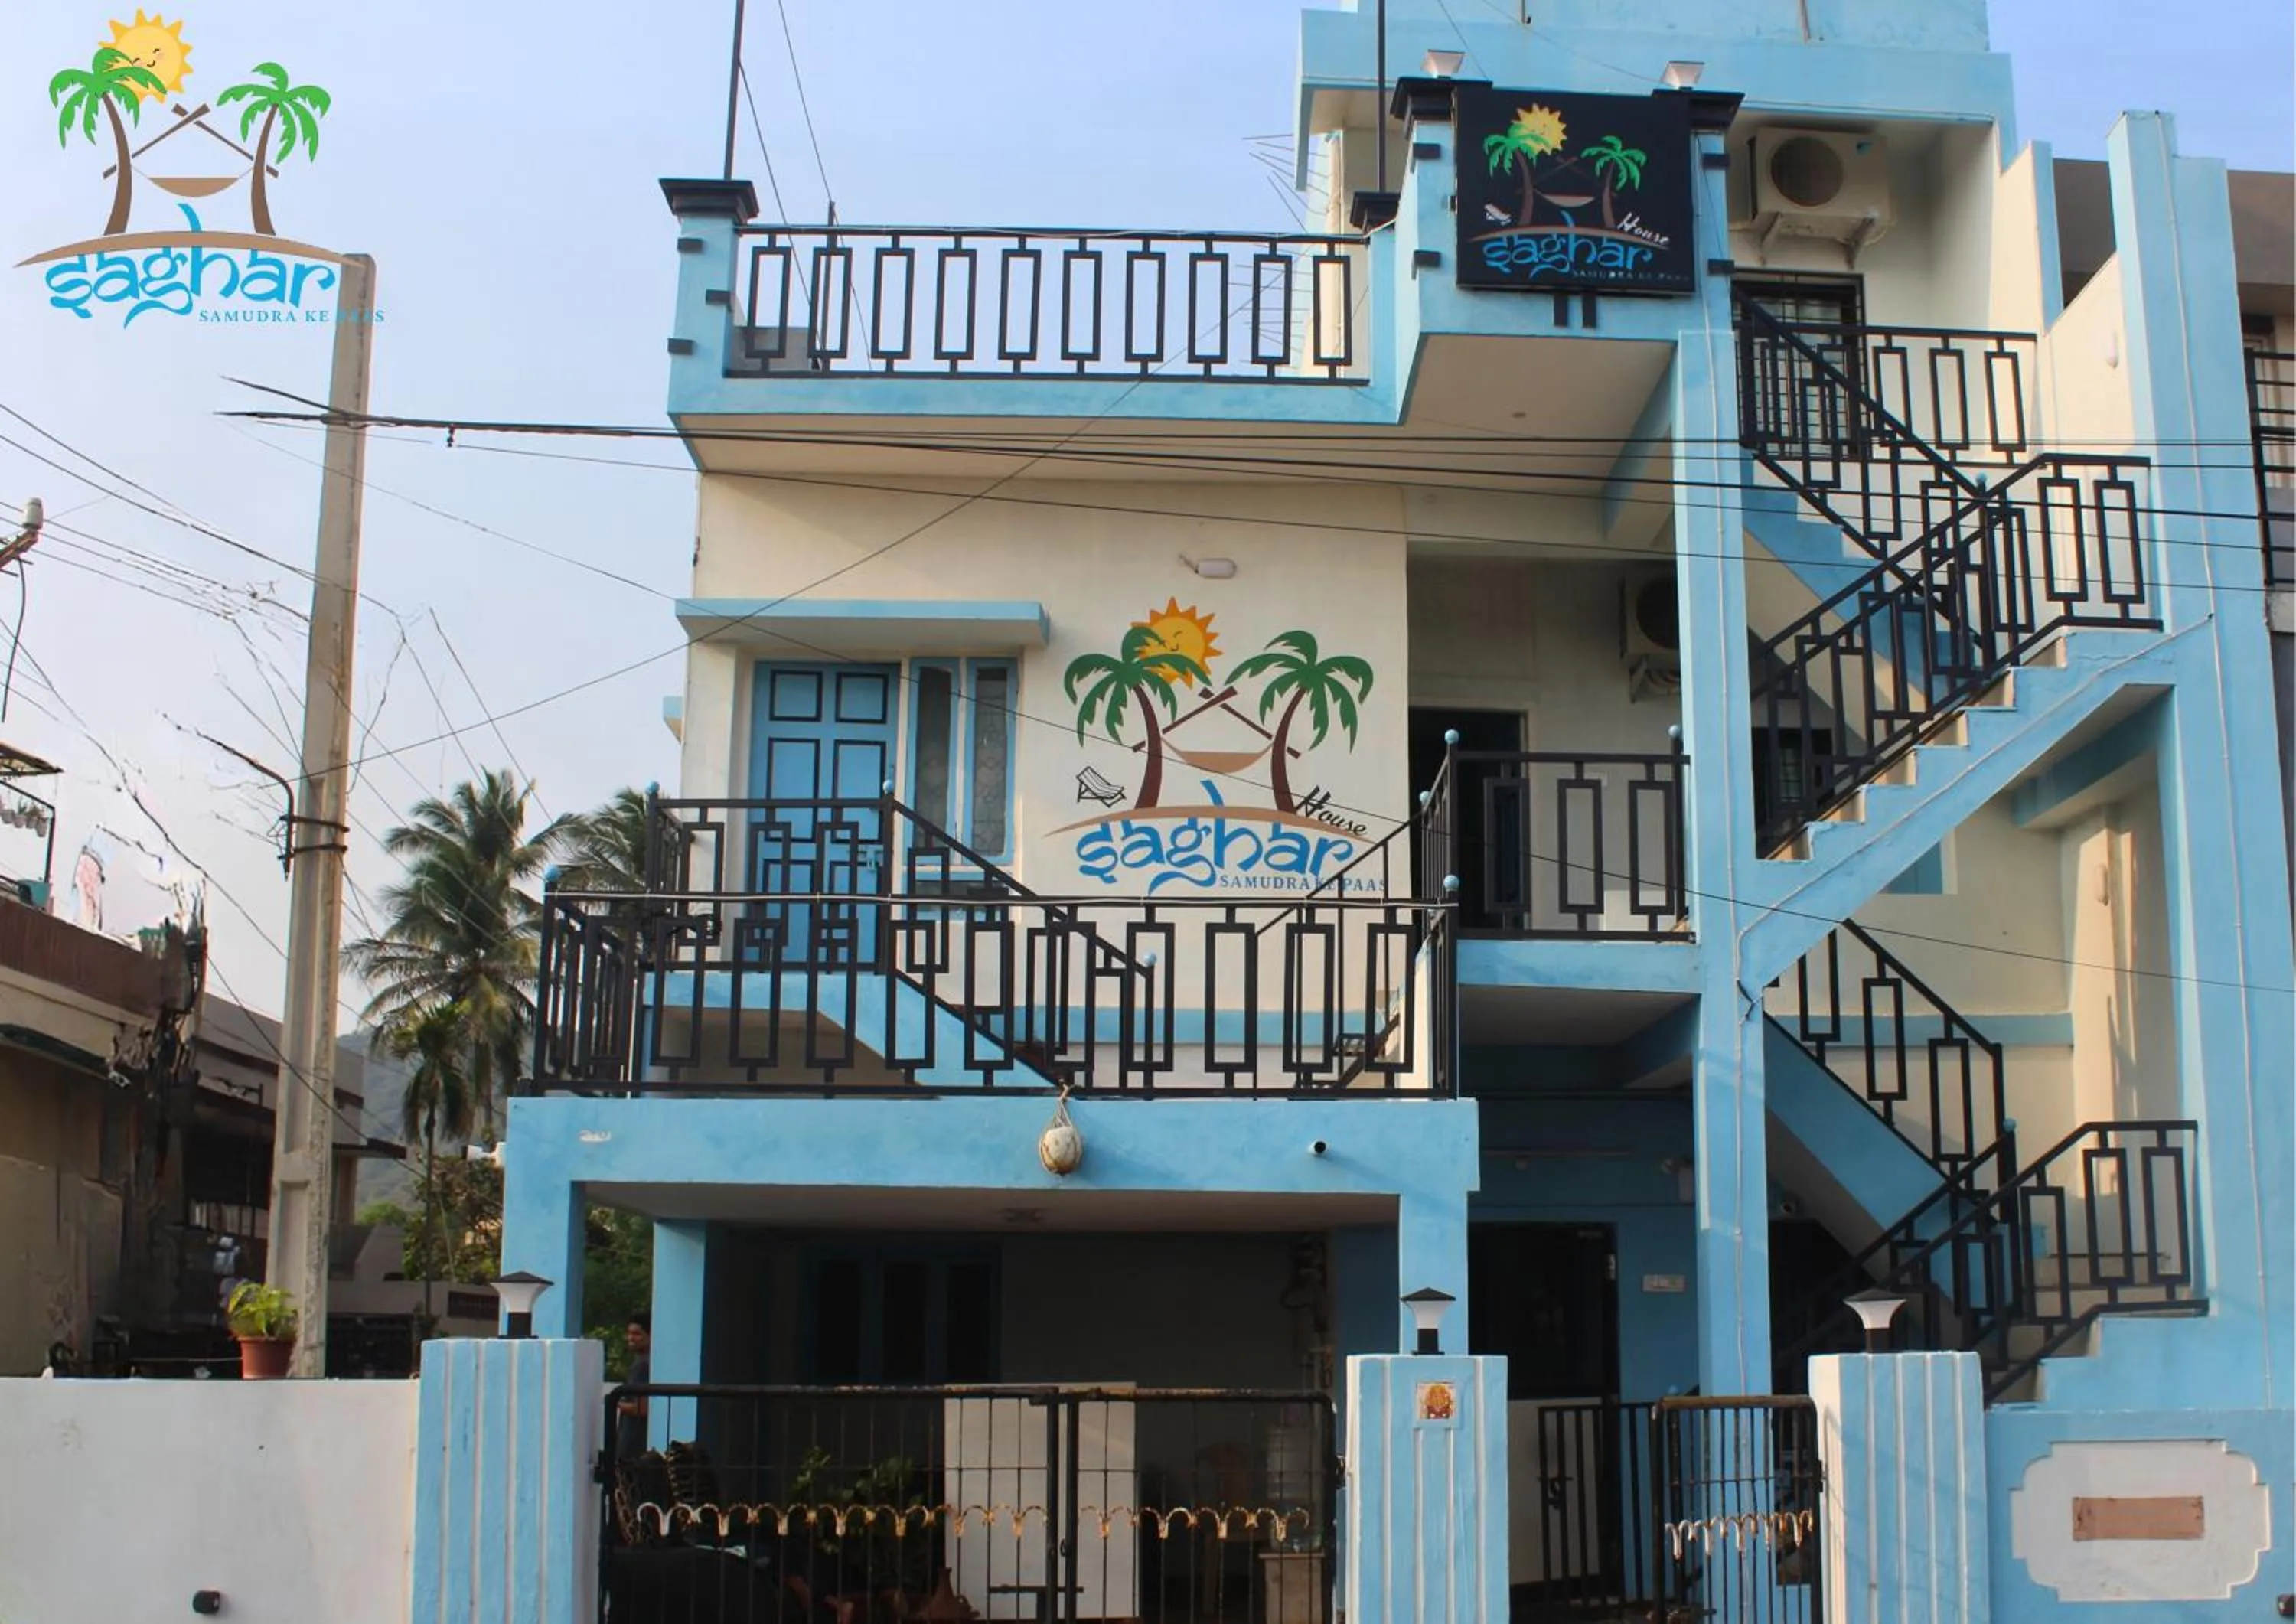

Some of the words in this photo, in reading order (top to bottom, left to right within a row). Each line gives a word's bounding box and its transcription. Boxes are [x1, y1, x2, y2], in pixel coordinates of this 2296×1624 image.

[1617, 212, 1670, 245] House
[1296, 785, 1367, 836] House
[1219, 874, 1310, 890] SAMUDRA
[1342, 877, 1385, 892] PAAS
